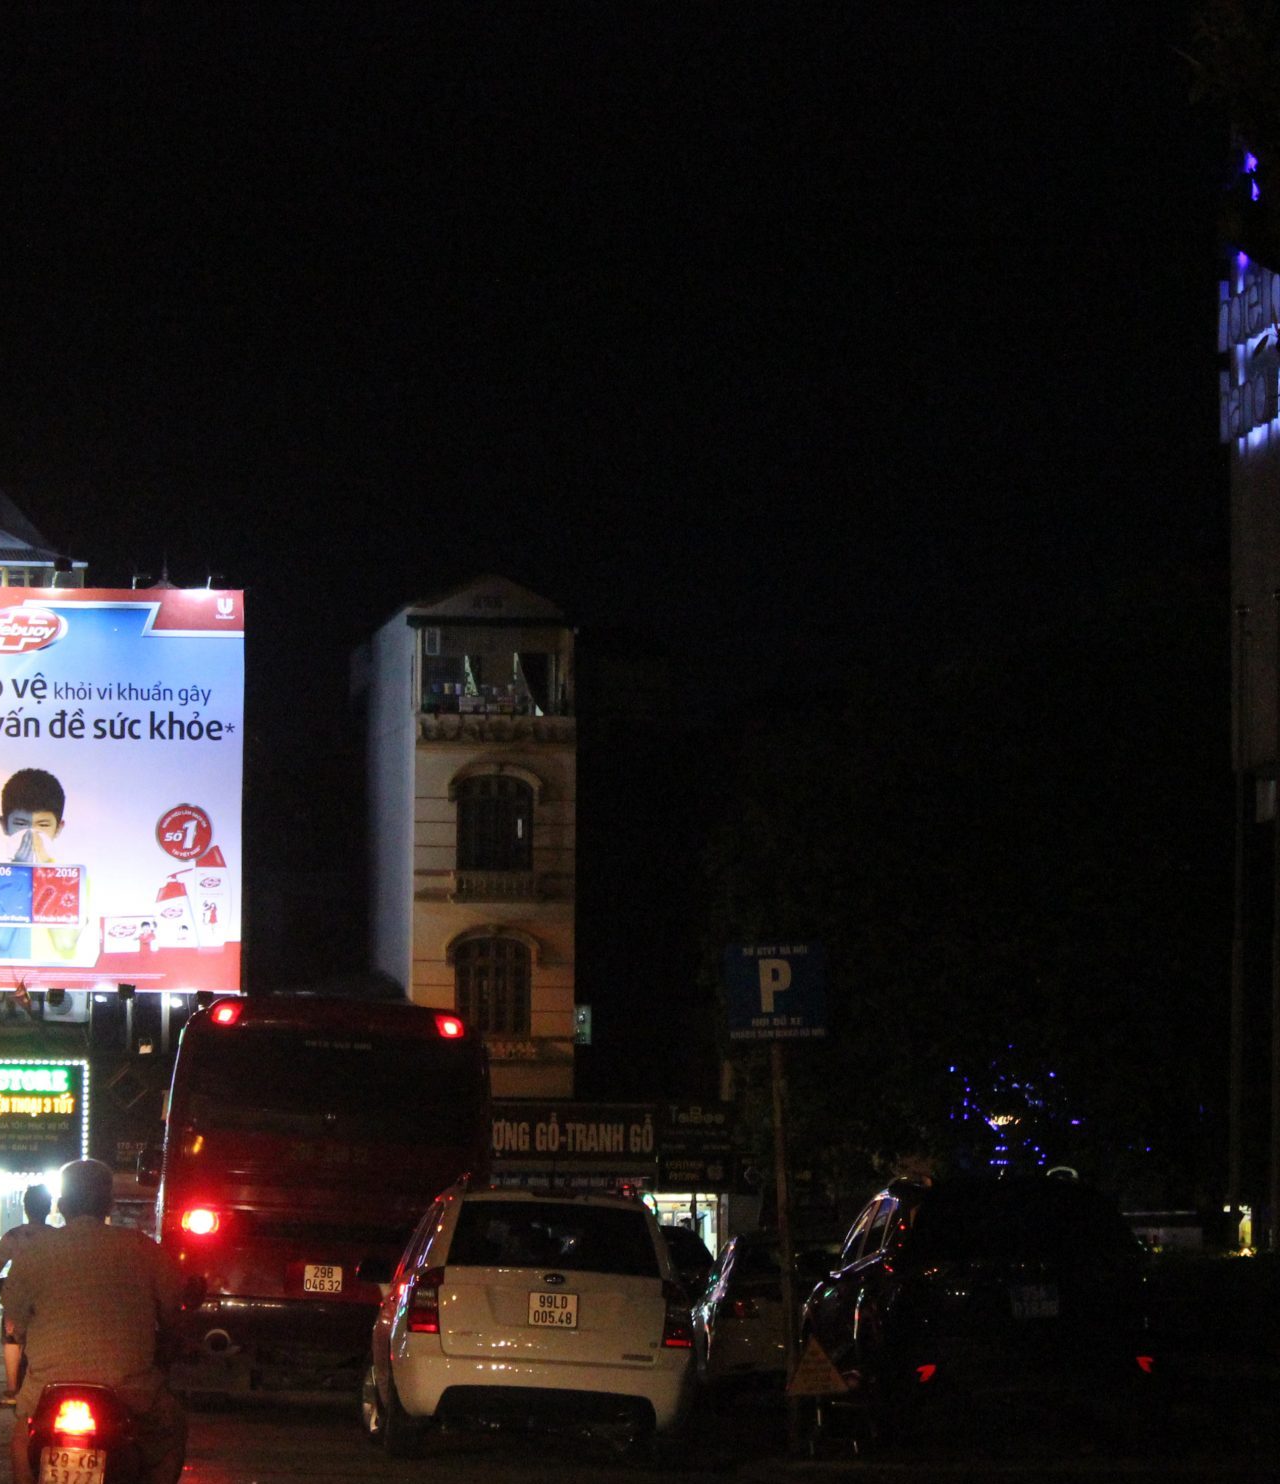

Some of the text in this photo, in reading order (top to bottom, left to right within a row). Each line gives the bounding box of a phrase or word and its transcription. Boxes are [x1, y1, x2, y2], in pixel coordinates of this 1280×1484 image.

[12, 672, 47, 704] vệ
[54, 681, 92, 700] khỏi
[97, 683, 112, 700] vi
[117, 681, 173, 701] khuẩn
[178, 685, 211, 706] gây
[49, 708, 85, 739] đề
[93, 712, 142, 740] sức
[183, 820, 198, 849] 1
[55, 868, 78, 877] 2016
[758, 958, 792, 1013] P
[539, 1295, 568, 1309] 99LD
[533, 1310, 573, 1325] 005.48
